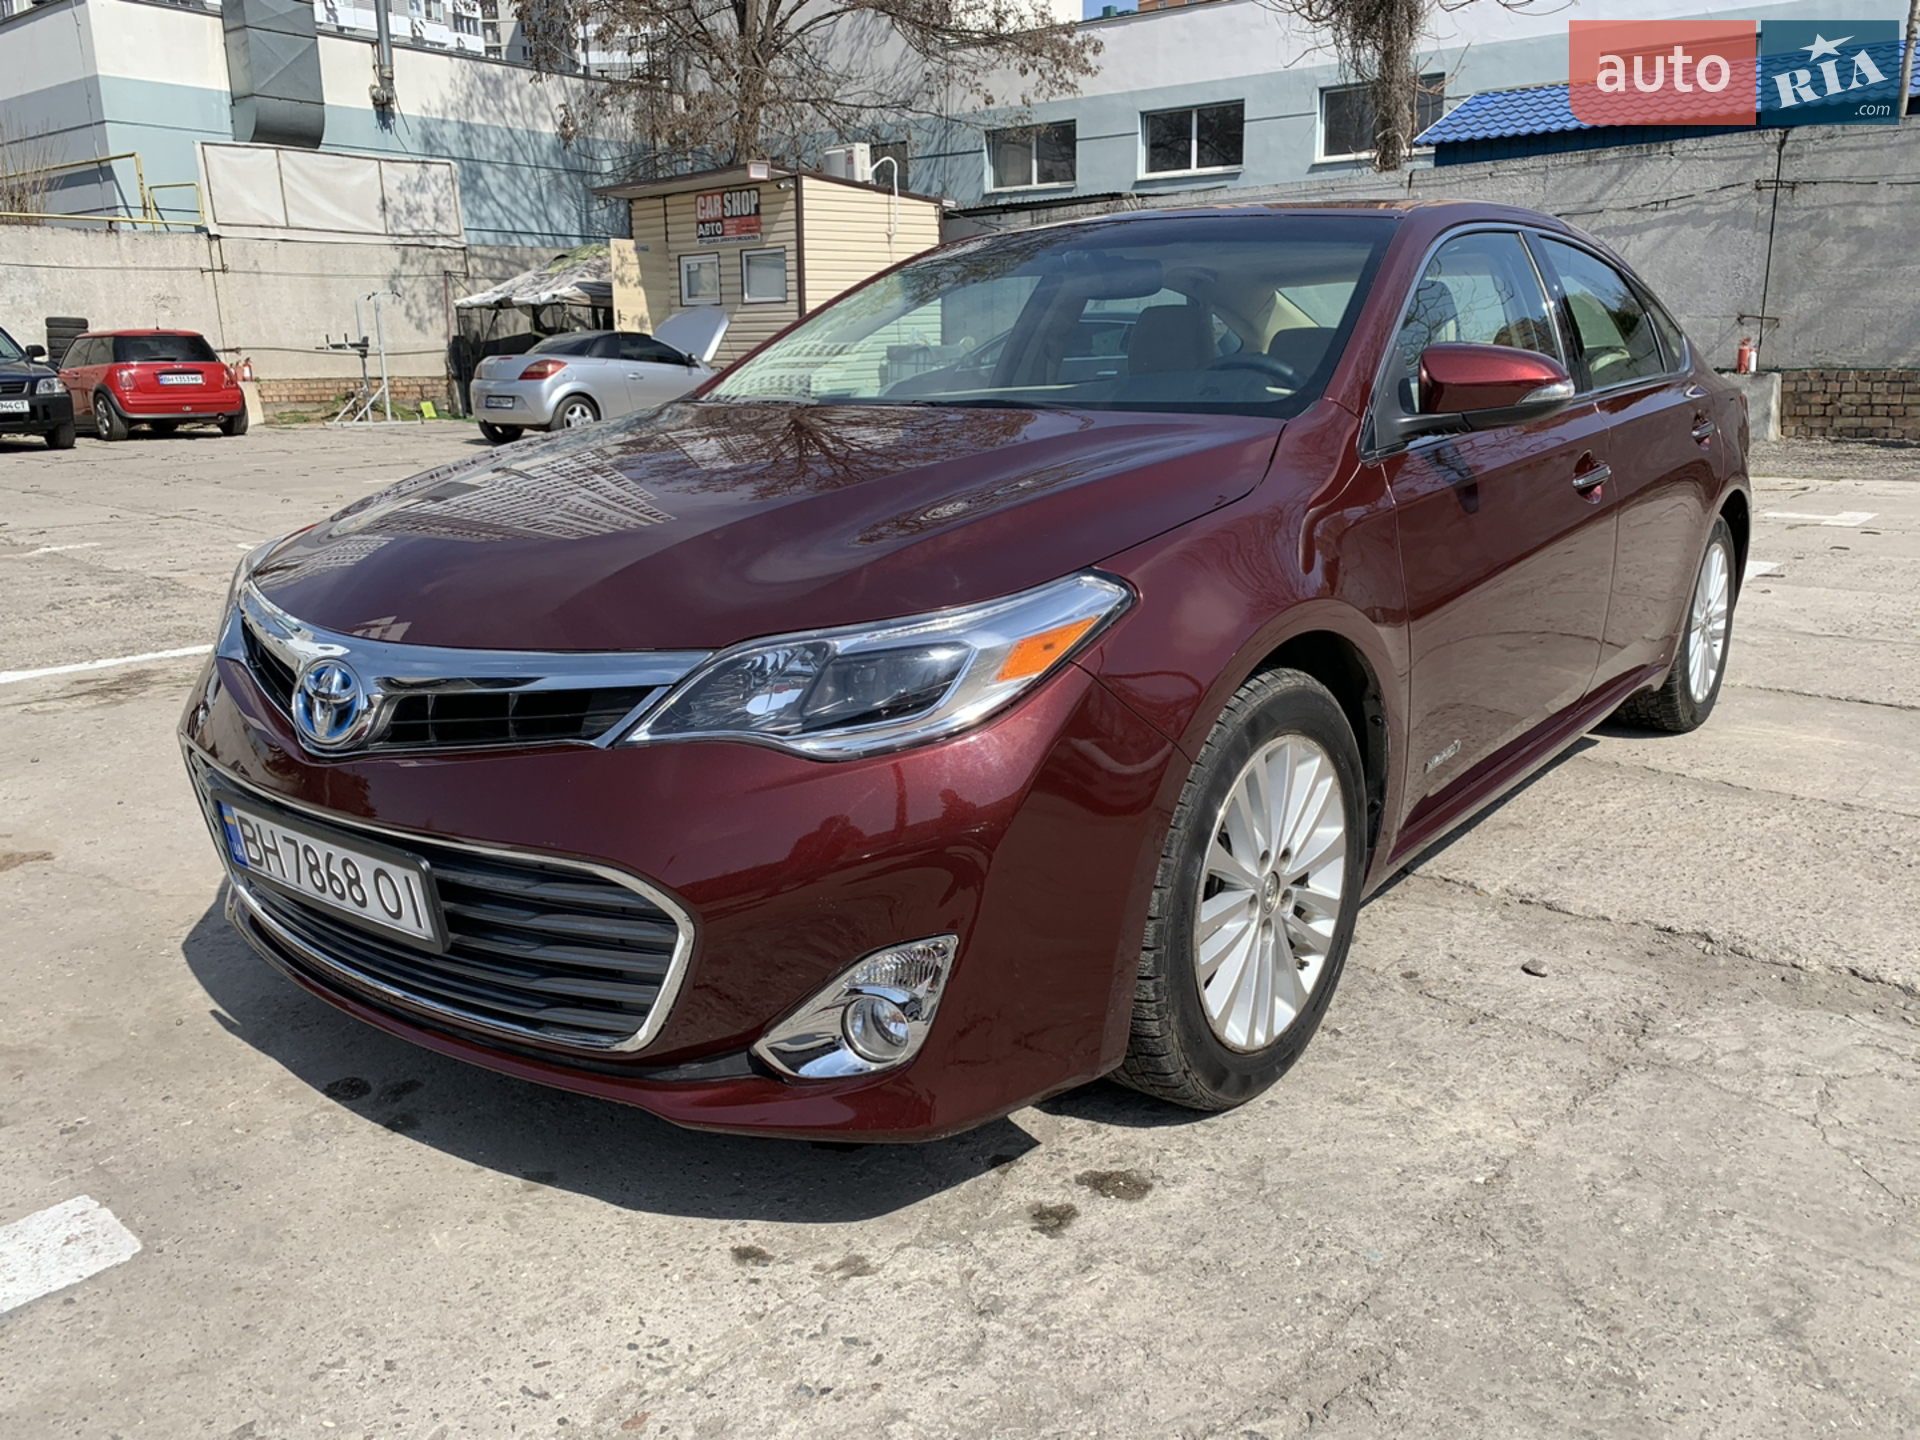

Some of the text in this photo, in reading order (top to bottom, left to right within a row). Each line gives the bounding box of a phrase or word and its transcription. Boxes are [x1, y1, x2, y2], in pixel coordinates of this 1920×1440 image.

[696, 189, 759, 220] CAR SHOP
[698, 222, 723, 237] АВТО
